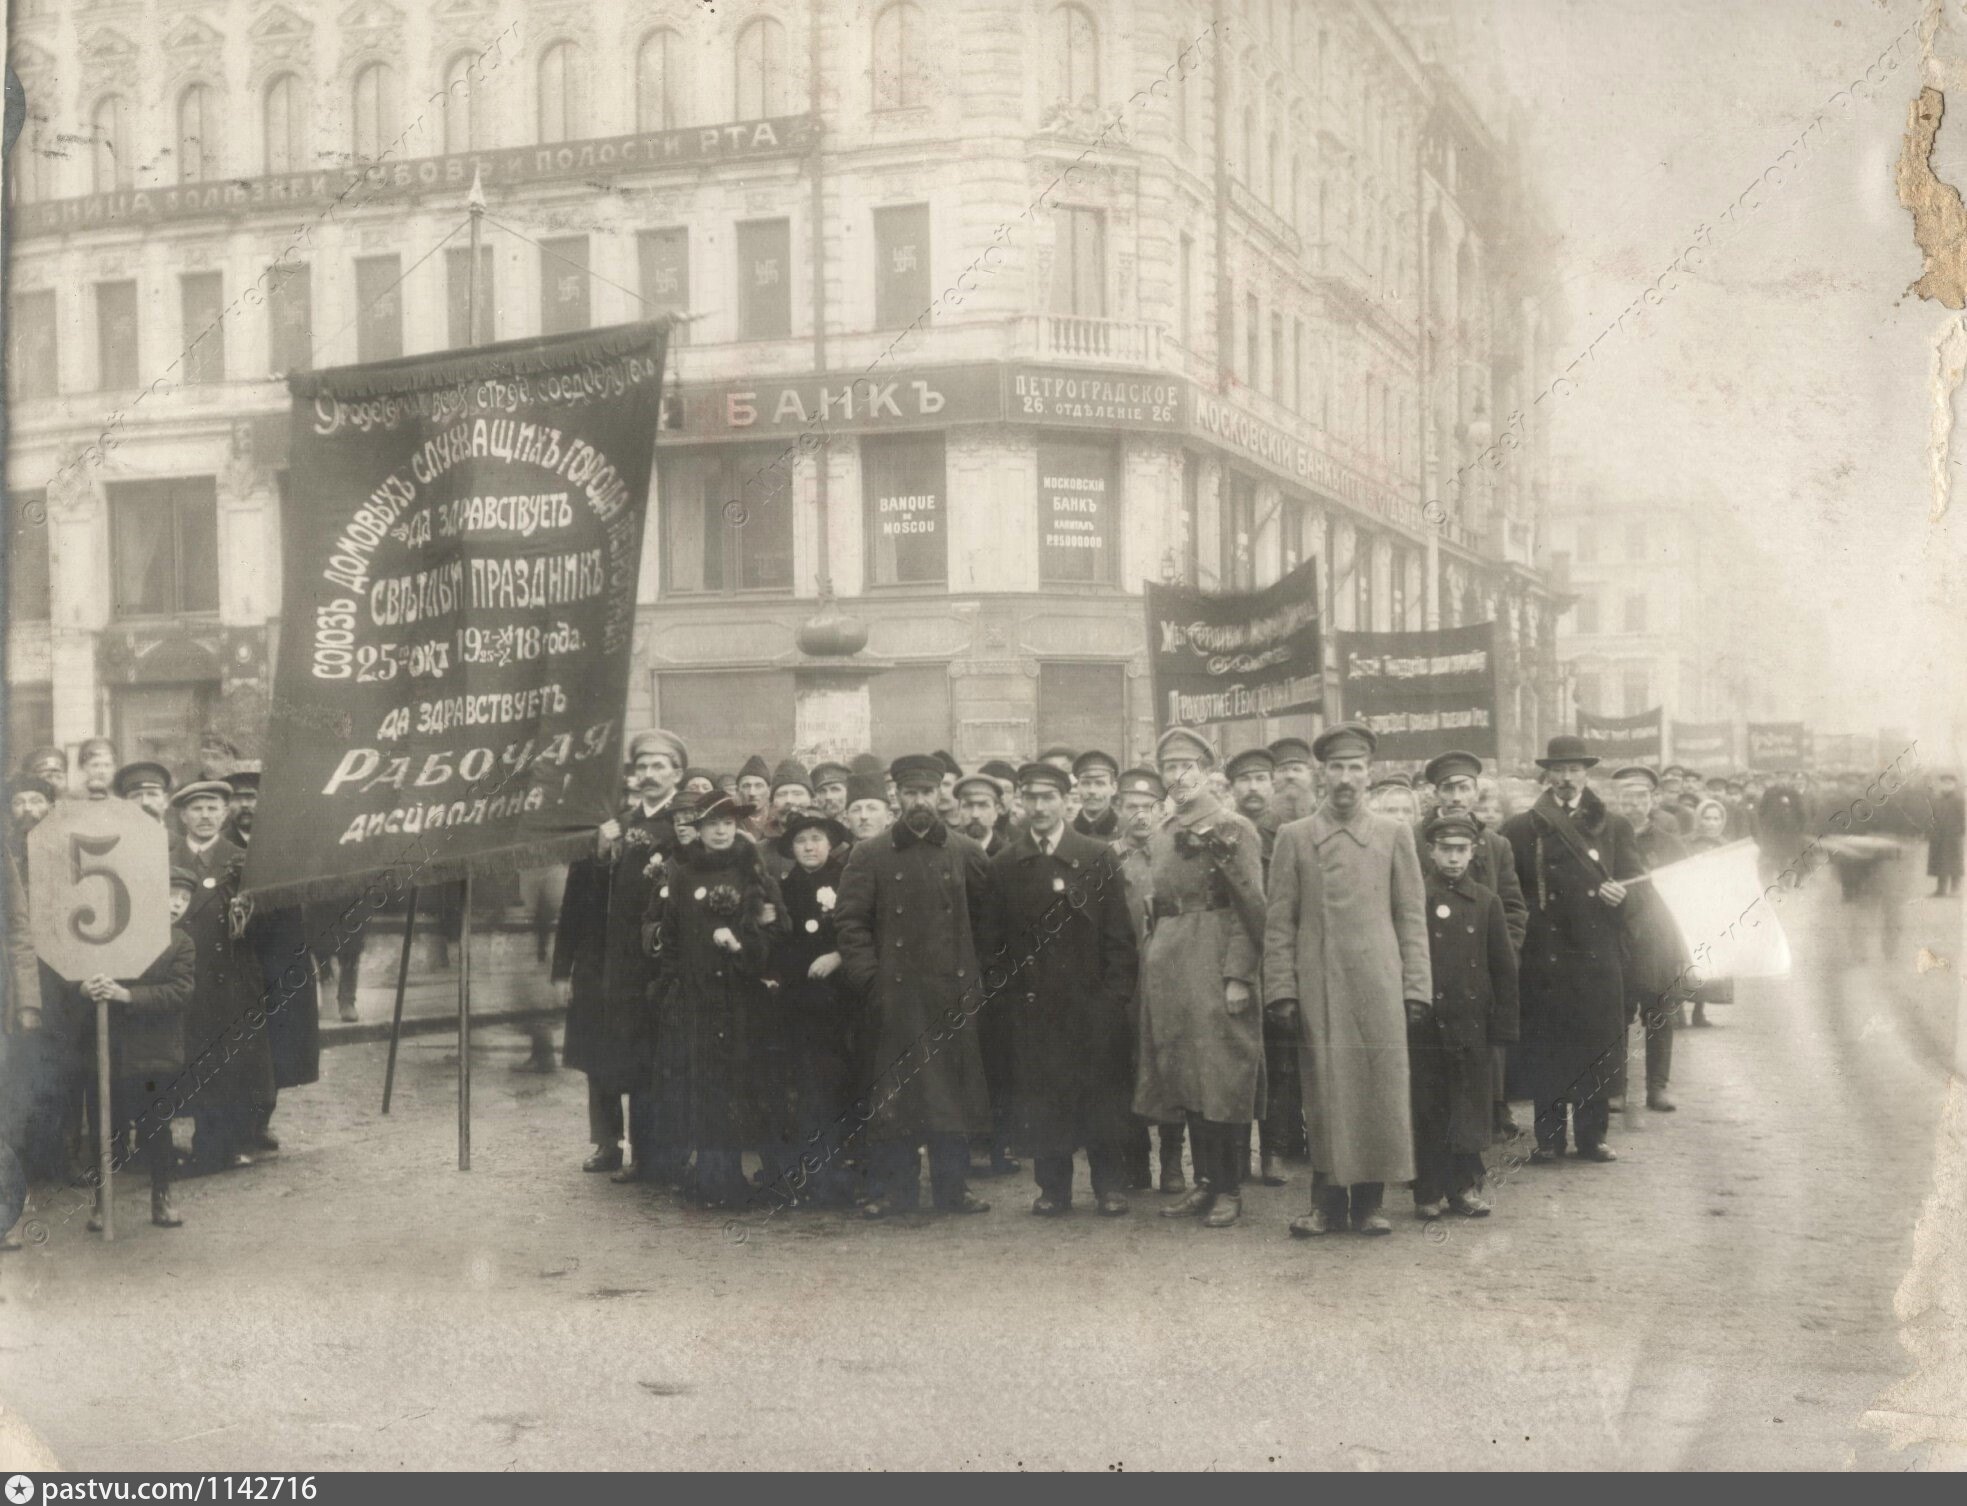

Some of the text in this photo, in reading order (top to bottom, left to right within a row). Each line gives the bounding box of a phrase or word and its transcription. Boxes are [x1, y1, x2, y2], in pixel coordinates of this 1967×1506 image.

[536, 136, 680, 171] ПОЛОСТИ
[699, 122, 779, 153] РТА
[727, 381, 946, 427] БАНКЪ
[1016, 375, 1178, 406] ПЕТРОГРАДСКОЕ
[412, 418, 562, 484] СЛУЖАЩИХЪ
[880, 495, 936, 512] BANQUE
[1043, 477, 1104, 491] МОСКОВСКІЙ
[1053, 496, 1097, 512] БАНКЪ
[323, 474, 416, 595] ДОМОВЫХЪ
[438, 491, 573, 538] ЗДРАВСТВУЕТЪ
[883, 520, 935, 534] MOSCOU
[470, 548, 604, 609] ПРАЗДНИКЪ
[312, 598, 357, 679] СОЮЗЪ
[377, 683, 567, 742] ДА ЗДРАВСТВУЕТЪ
[320, 719, 615, 795] РАБОЧАЯ
[67, 832, 131, 946] 5
